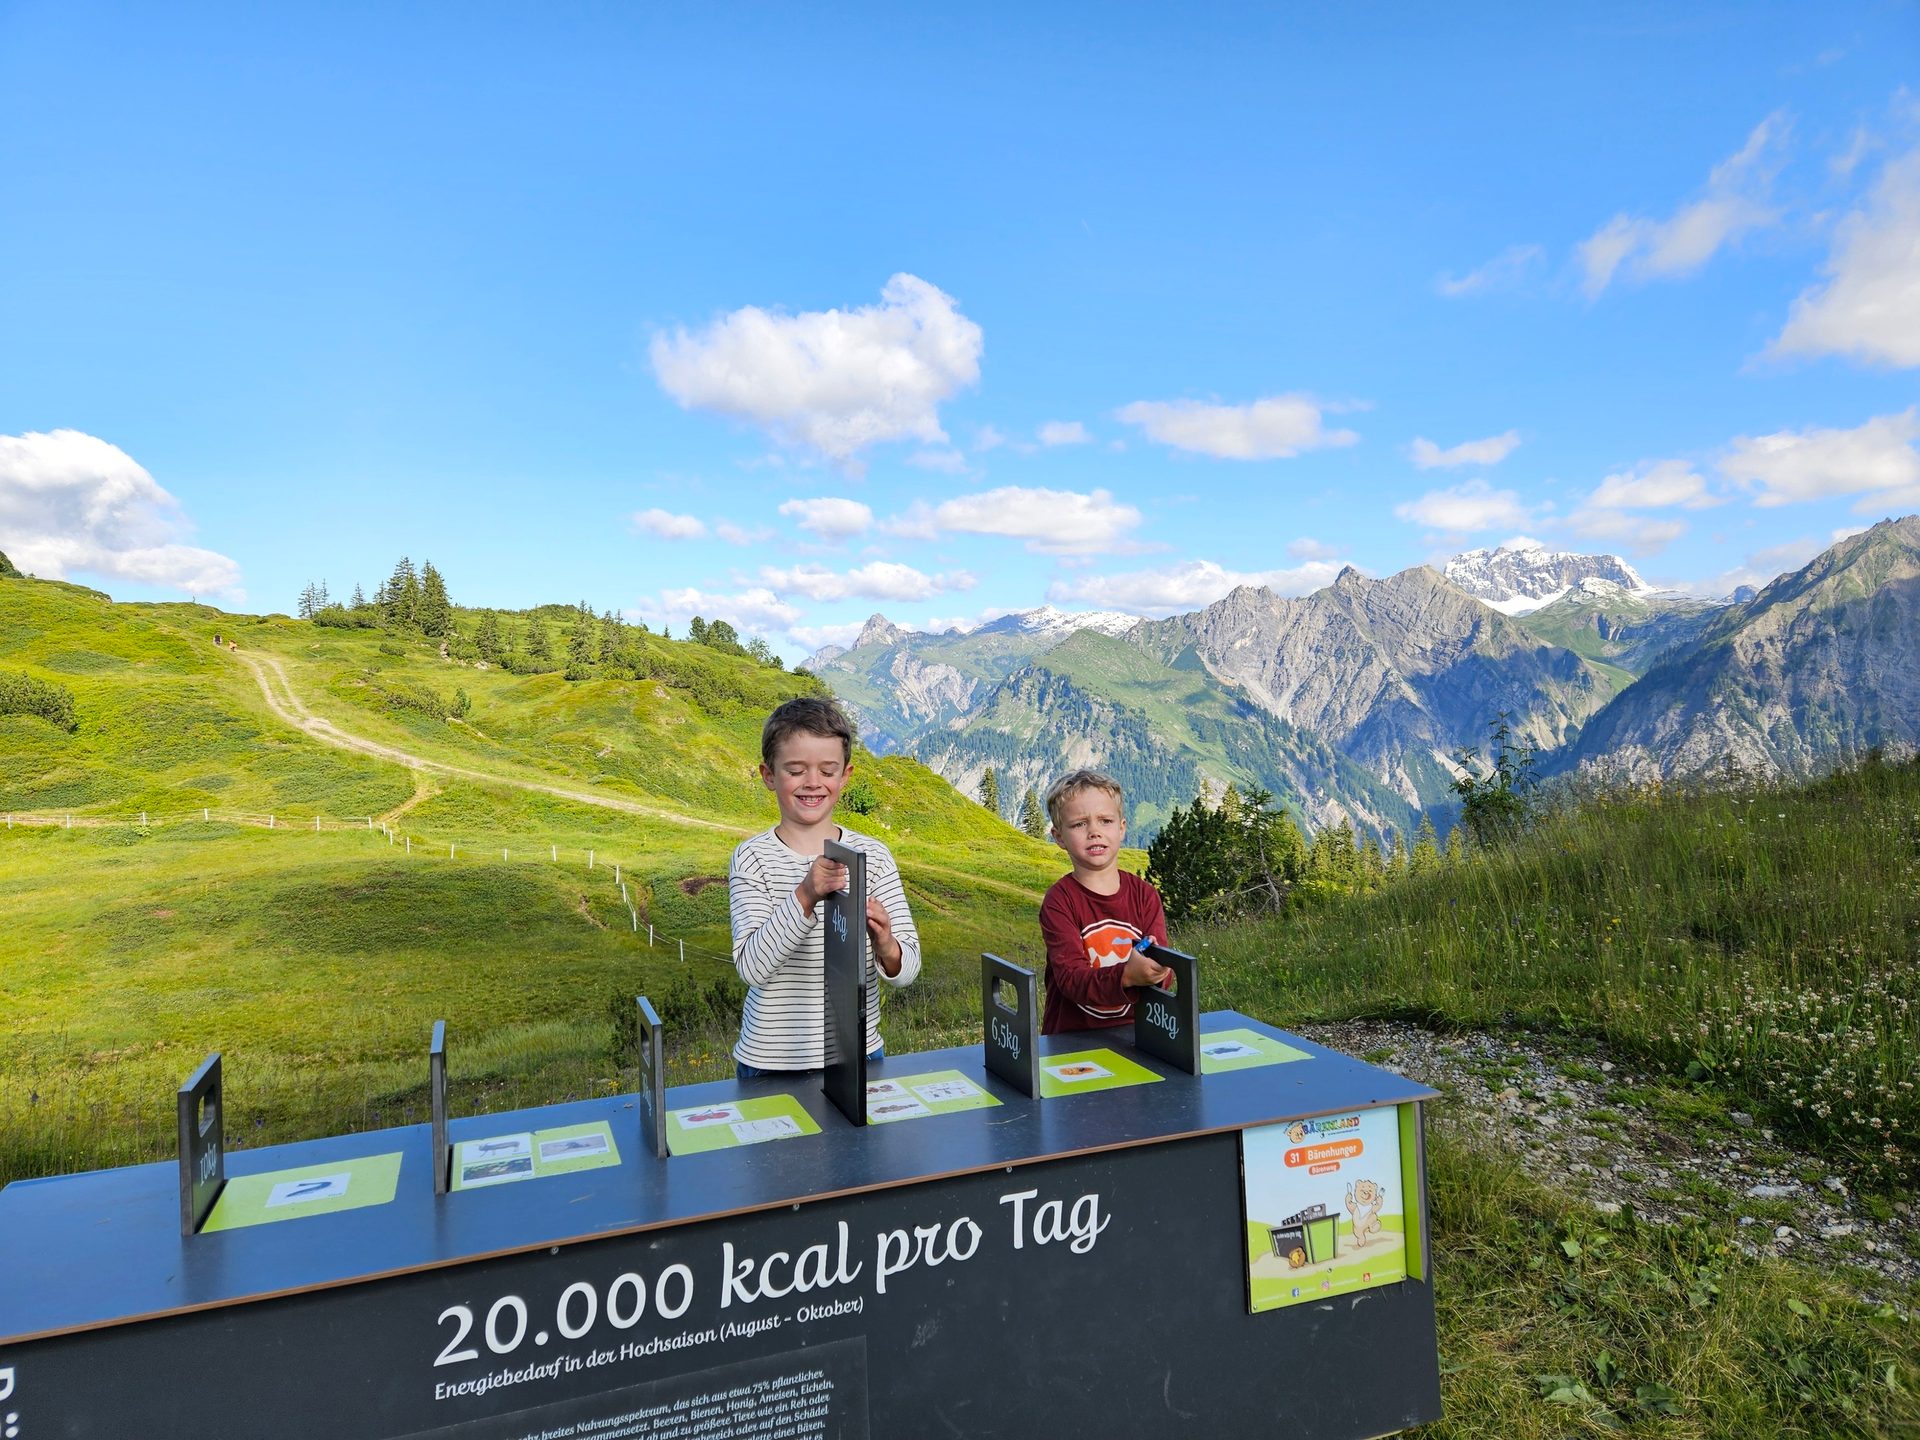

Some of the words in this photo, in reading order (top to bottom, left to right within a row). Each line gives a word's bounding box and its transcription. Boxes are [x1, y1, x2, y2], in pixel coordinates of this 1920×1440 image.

[832, 904, 848, 942] 4kg
[992, 1016, 1021, 1060] 6,5kg
[1146, 1002, 1179, 1040] 28kg
[1290, 1153, 1300, 1164] 31
[1307, 1145, 1357, 1161] Bärenhunger
[433, 1264, 694, 1367] 20.000
[720, 1221, 864, 1309] kcal
[876, 1216, 983, 1294] pro
[1000, 1189, 1112, 1254] Tag
[435, 1355, 565, 1400] Energiebedarf
[565, 1355, 584, 1372] in
[586, 1349, 617, 1368] der
[620, 1329, 718, 1361] Hochsaison
[720, 1315, 782, 1343] (August
[797, 1296, 865, 1323] Oktober)
[541, 1426, 574, 1440] breites
[576, 1404, 671, 1434] Nahrungsspektrum,
[672, 1399, 689, 1412] das
[690, 1393, 710, 1408] sich
[711, 1391, 727, 1403] aus
[728, 1385, 751, 1399] etwa
[752, 1380, 770, 1394] 75%
[771, 1370, 824, 1391] pflanzlicher
[653, 1413, 687, 1429] Beeren,
[690, 1405, 723, 1421] Bienen,
[726, 1396, 756, 1412] Honig,
[758, 1388, 798, 1405] Ameisen,
[800, 1379, 834, 1395] Eicheln,
[659, 1426, 679, 1440] und
[679, 1426, 692, 1436] zu
[693, 1416, 731, 1435] größere
[732, 1410, 756, 1424] Tiere
[756, 1405, 773, 1418] wie
[774, 1402, 789, 1414] ein
[790, 1396, 807, 1410] Reh
[808, 1392, 830, 1406] oder
[735, 1422, 758, 1436] oder
[759, 1416, 775, 1430] auf
[775, 1414, 792, 1427] den
[793, 1403, 828, 1422] Schädel
[773, 1427, 795, 1440] eines
[797, 1420, 825, 1434] Bären.
